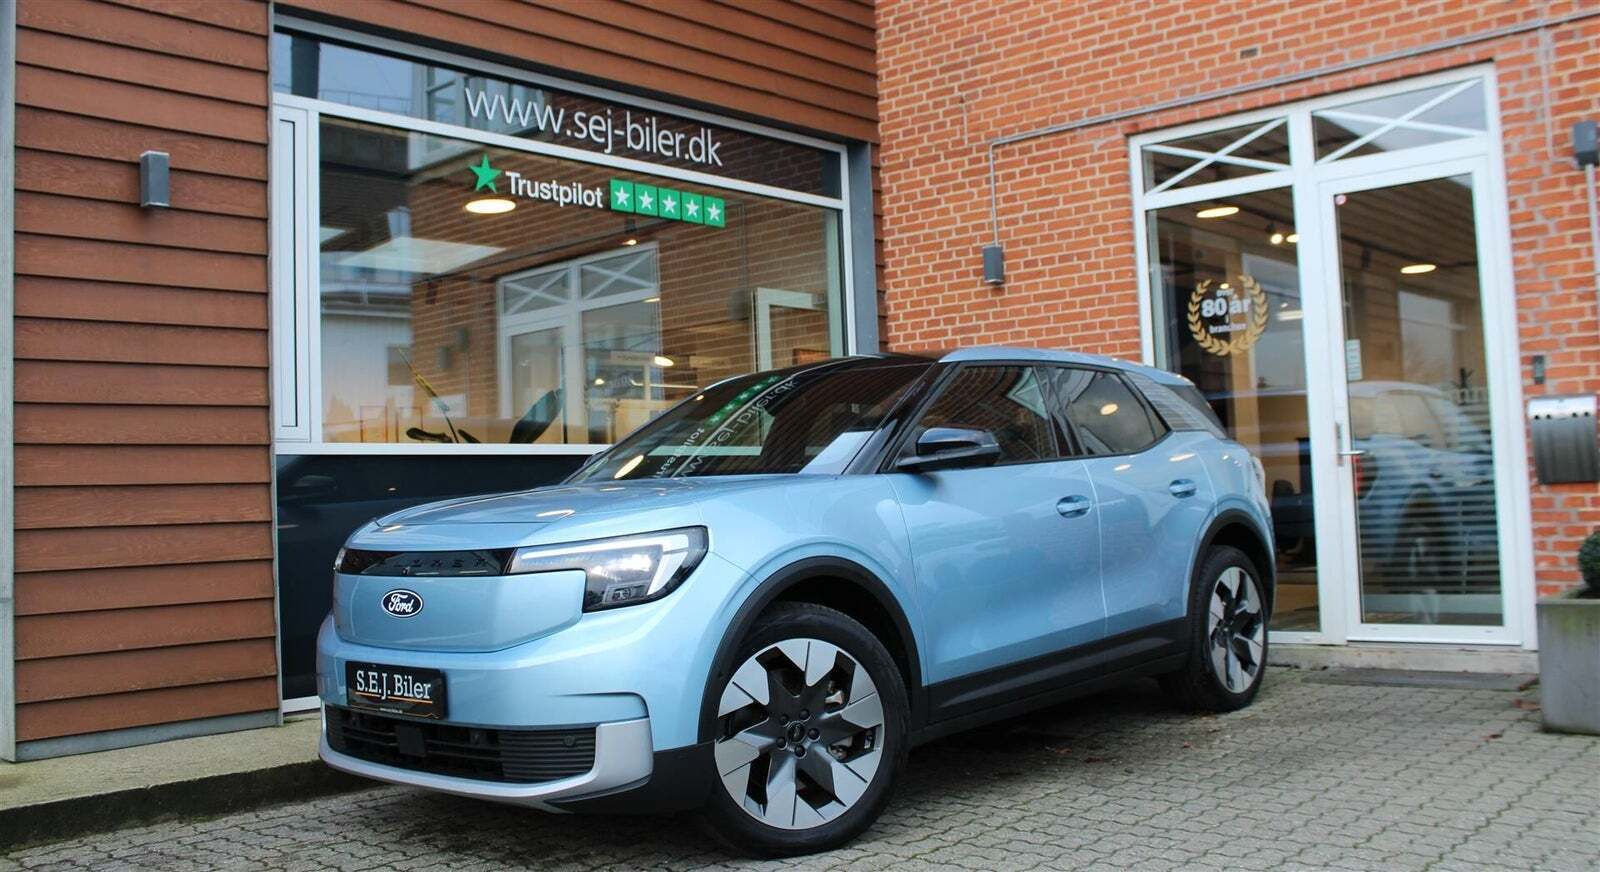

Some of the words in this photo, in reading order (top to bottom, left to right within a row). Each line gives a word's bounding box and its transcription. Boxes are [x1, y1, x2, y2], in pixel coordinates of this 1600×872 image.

[465, 87, 723, 167] www.sej-biler.dk
[505, 170, 603, 208] Trustpilot
[1201, 297, 1228, 317] 80
[1230, 293, 1251, 313] år
[388, 593, 414, 613] Ford
[356, 669, 391, 700] S.E.J.
[394, 673, 432, 699] Biler
